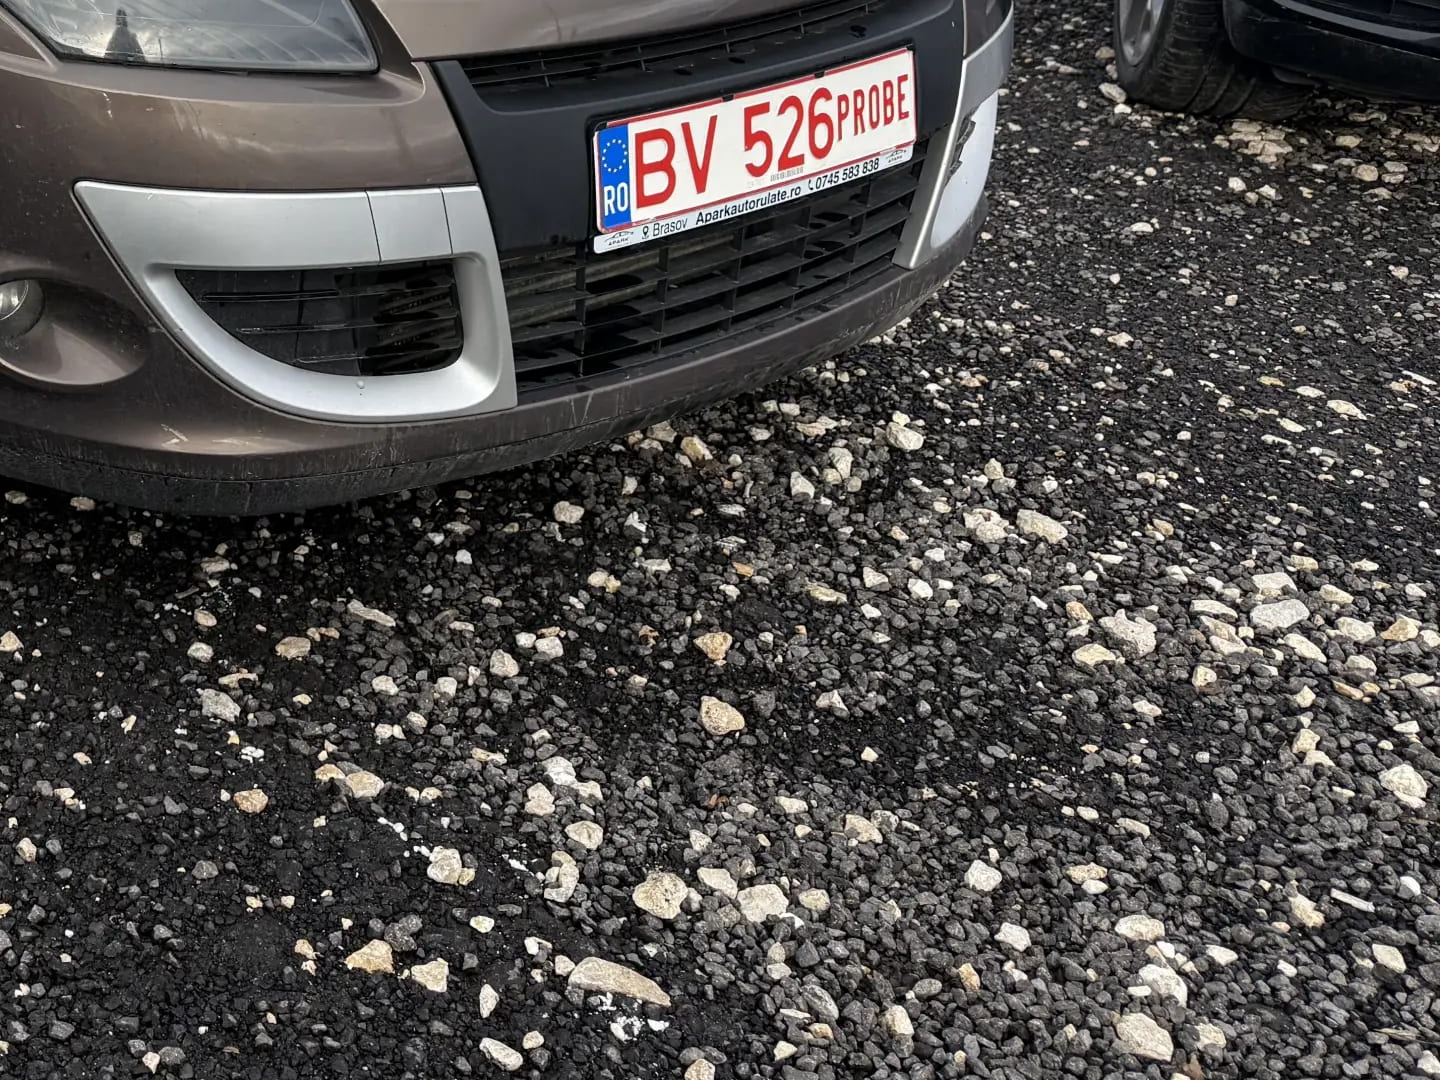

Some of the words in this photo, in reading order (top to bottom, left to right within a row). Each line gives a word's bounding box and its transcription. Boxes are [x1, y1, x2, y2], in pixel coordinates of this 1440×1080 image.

[604, 181, 629, 217] RO
[635, 114, 718, 209] BV
[652, 217, 690, 237] Brasov
[695, 186, 802, 226] Aparkautorulate.ro
[815, 171, 841, 190] 0745
[842, 164, 860, 183] 583
[862, 157, 880, 176] 838
